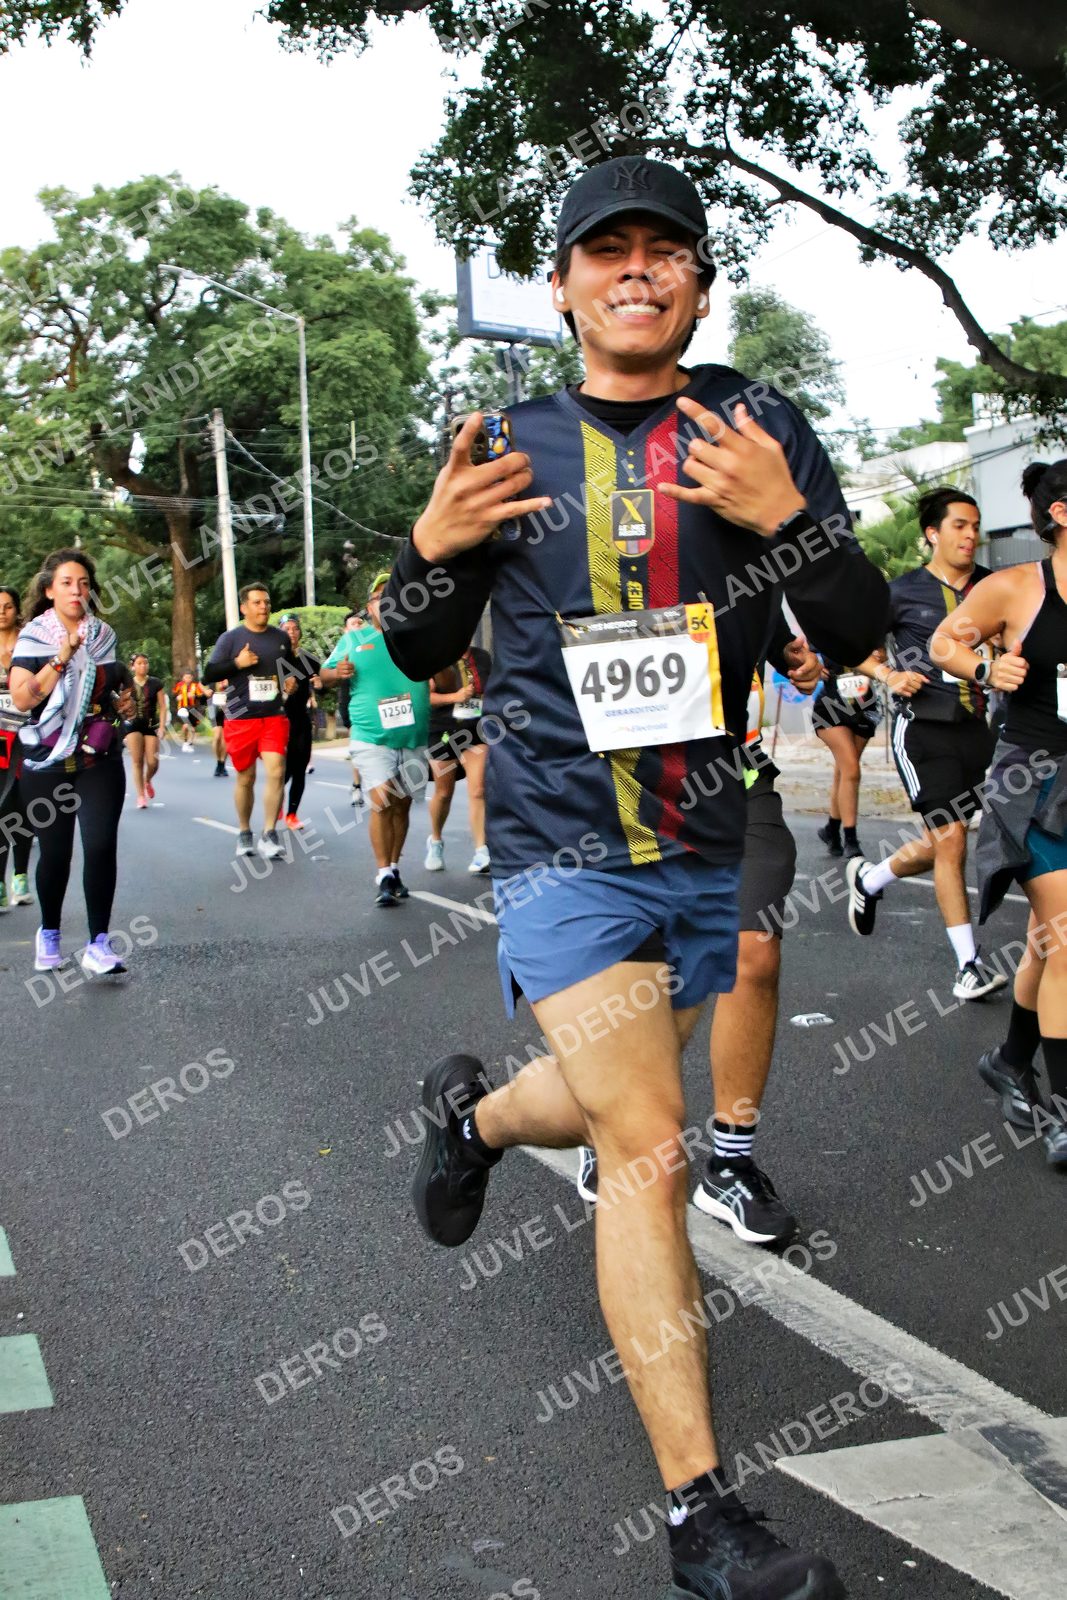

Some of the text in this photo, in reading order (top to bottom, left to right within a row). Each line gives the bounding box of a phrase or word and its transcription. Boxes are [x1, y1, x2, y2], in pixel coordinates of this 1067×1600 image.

[691, 616, 709, 630] 5K
[581, 652, 686, 702] 4969
[382, 703, 412, 718] 12507
